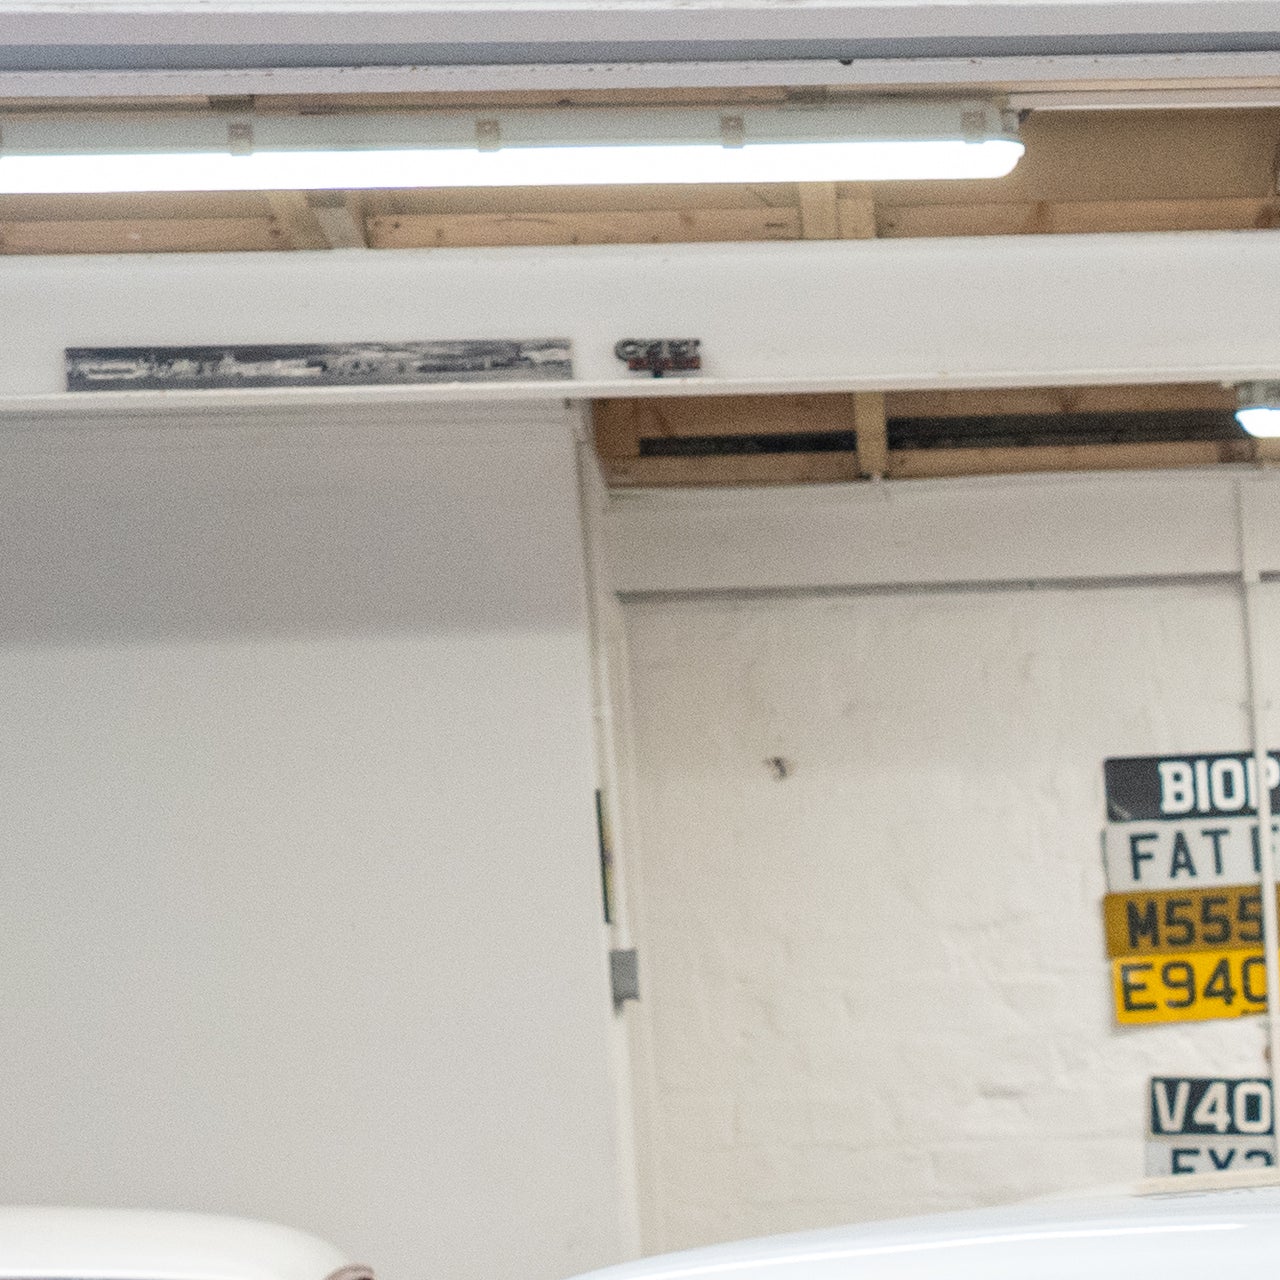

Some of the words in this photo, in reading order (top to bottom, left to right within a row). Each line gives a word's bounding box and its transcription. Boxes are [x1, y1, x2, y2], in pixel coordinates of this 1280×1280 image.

[1129, 828, 1230, 881] FAT
[1126, 895, 1265, 949] M555
[1120, 957, 1268, 1013] E940
